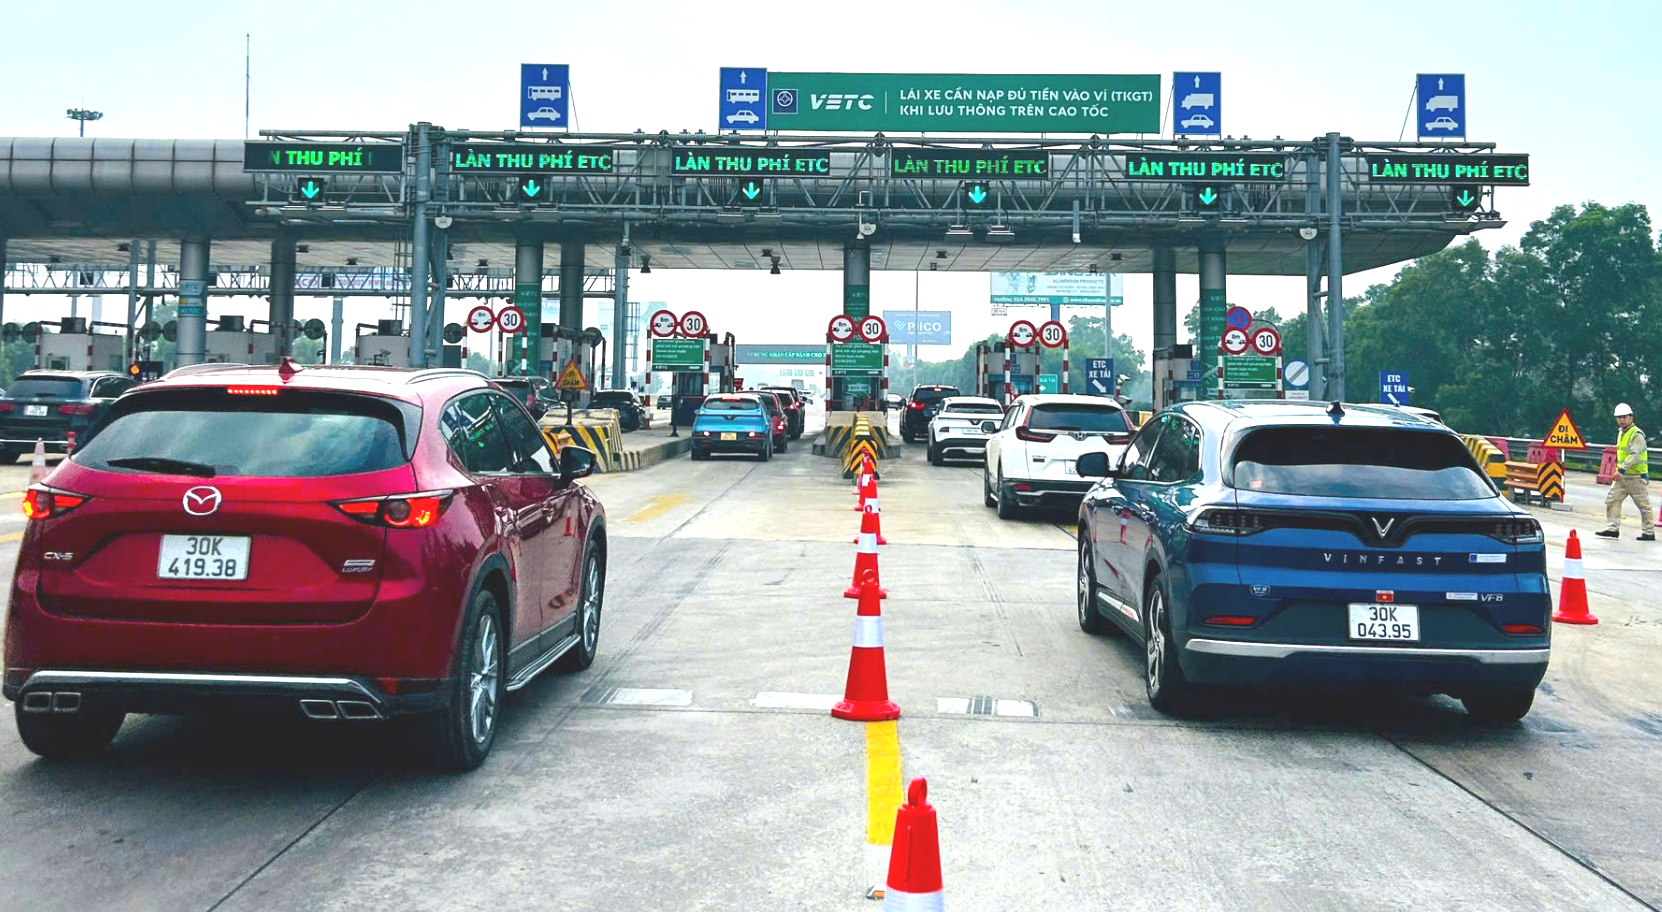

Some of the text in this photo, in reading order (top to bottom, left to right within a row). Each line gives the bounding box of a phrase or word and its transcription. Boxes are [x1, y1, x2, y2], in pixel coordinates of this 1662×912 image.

[810, 94, 874, 110] VETC
[900, 88, 920, 100] LÁI
[924, 89, 941, 100] XE
[977, 90, 1004, 103] NẠP
[1008, 87, 1026, 100] ĐỦ
[1063, 89, 1090, 101] VÀO
[1093, 88, 1107, 101] VÍ
[1111, 90, 1153, 102] (TKGT)
[900, 103, 1109, 117] KHI LƯU THÔNG TRÊN CAO TỐC
[285, 150, 323, 165] THU
[328, 147, 362, 166] PHÍ
[456, 149, 611, 170] LÀN THU PHÍ ETC
[675, 152, 828, 173] LÀN THU PHÍ ETC
[894, 154, 1047, 174] LÀN THU PHÍ ETC
[1128, 156, 1283, 178] LÀN THU PHÍ ETC
[1372, 158, 1527, 180] LÀN THU PHÍ ETC
[504, 314, 517, 326] 30
[687, 318, 701, 331] 30
[866, 323, 879, 335] 30
[1046, 328, 1060, 341] 30
[1260, 335, 1273, 348] 30
[1093, 360, 1106, 369] ETC
[1088, 368, 1111, 378] XE TẢI
[1387, 374, 1401, 383] ETC
[1383, 382, 1406, 393] XE TẢI
[1558, 425, 1569, 433] ĐI
[1550, 434, 1578, 445] CHẬM
[186, 537, 224, 556] 30K
[43, 551, 74, 560] CX-5
[1323, 552, 1442, 566] VINFAST
[168, 557, 236, 577] 419.38
[1369, 606, 1398, 622] 30K
[1357, 623, 1411, 639] 043.95
